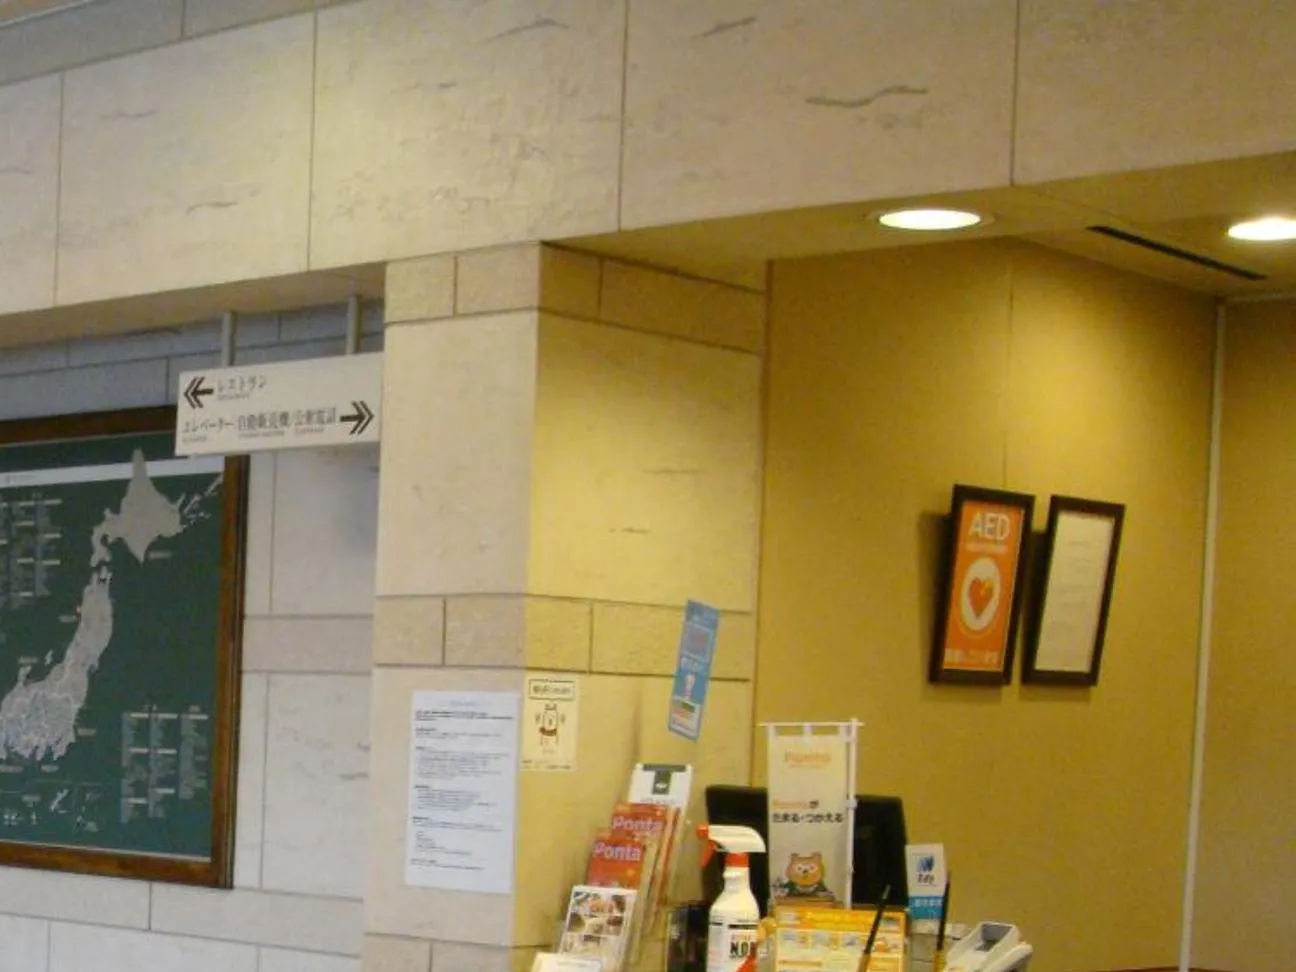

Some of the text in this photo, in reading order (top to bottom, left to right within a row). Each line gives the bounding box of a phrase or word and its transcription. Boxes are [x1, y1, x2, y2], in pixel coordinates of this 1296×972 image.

[968, 511, 1011, 541] AED
[612, 815, 665, 834] Ponta
[592, 841, 642, 862] Ponta
